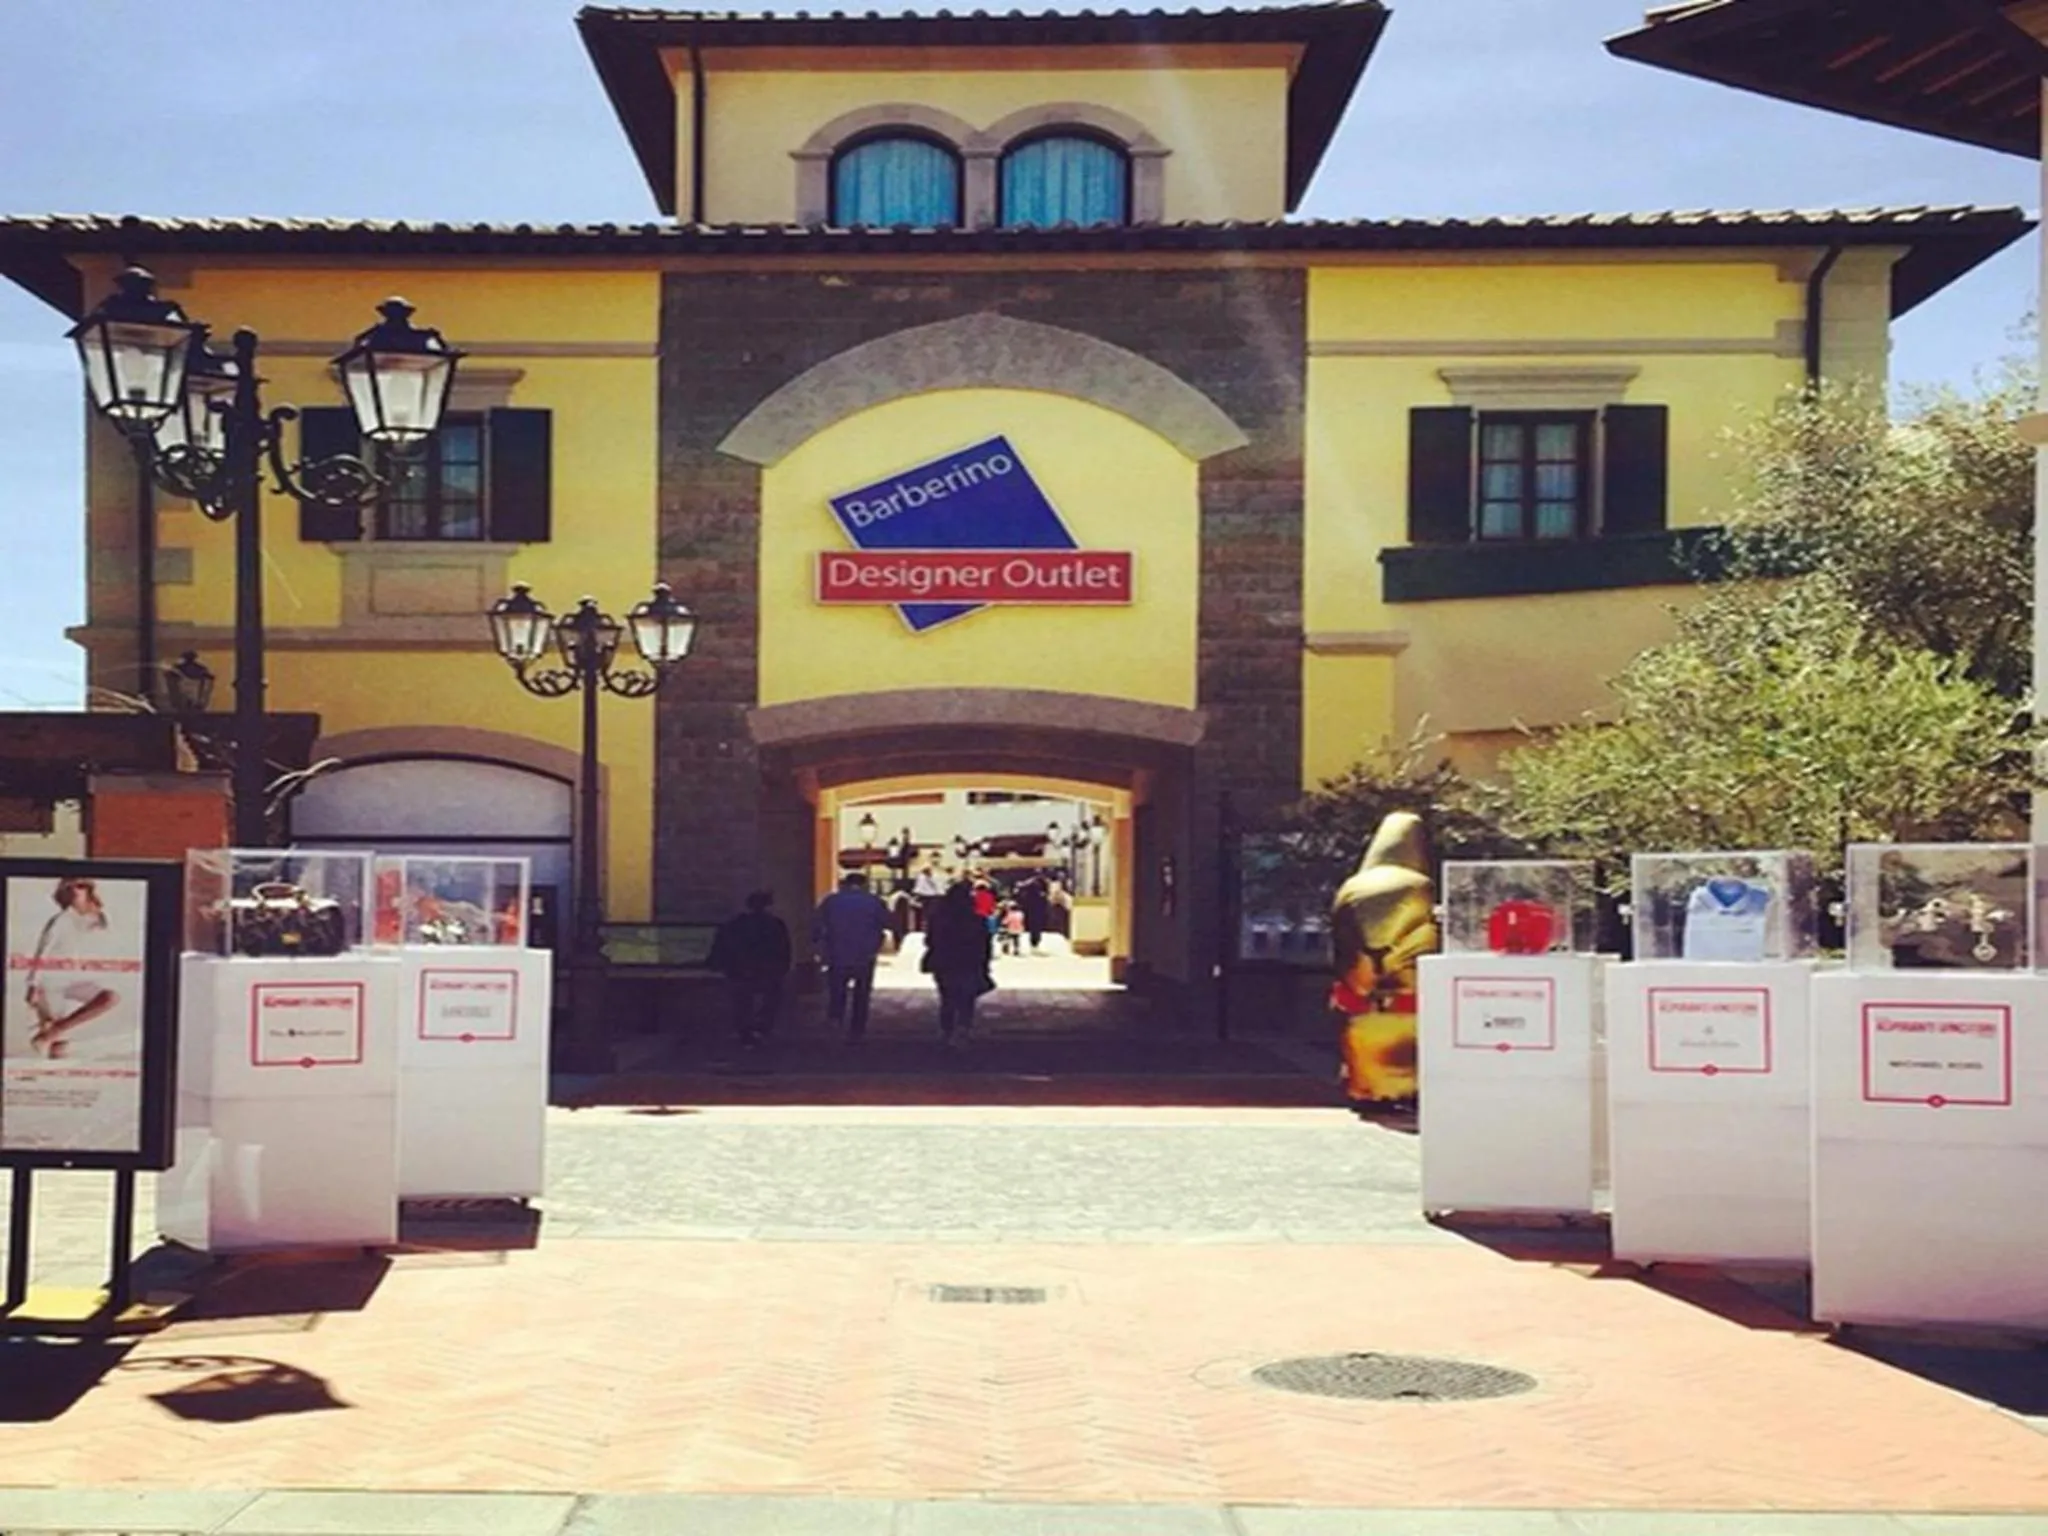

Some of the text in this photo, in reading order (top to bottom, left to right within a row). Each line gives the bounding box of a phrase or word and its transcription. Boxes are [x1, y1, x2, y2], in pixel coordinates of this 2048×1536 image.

[845, 453, 1013, 528] Barberino
[829, 559, 1121, 594] Designer Outlet
